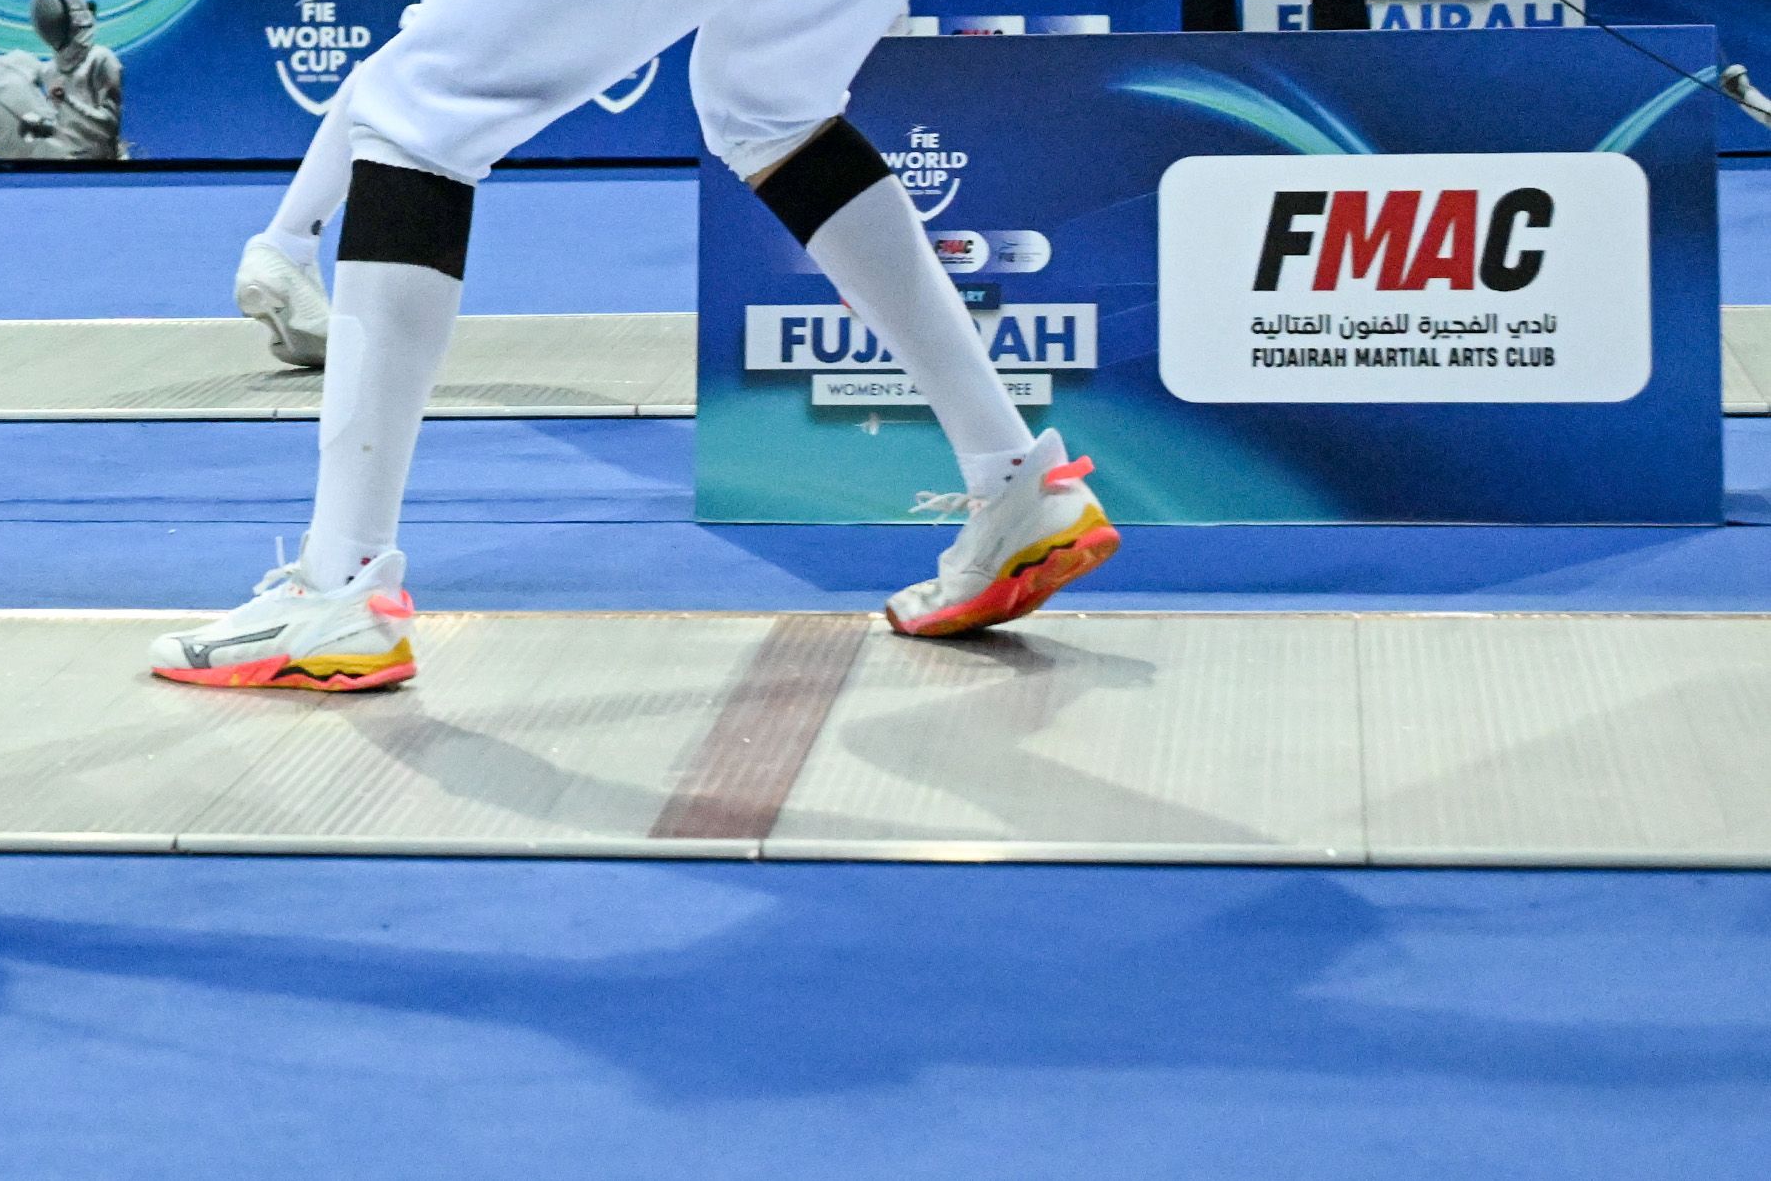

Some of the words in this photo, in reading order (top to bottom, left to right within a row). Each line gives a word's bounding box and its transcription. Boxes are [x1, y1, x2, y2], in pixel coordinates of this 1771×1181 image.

[301, 2, 336, 22] FIE
[265, 25, 371, 49] WORLD
[290, 49, 347, 72] CUP
[911, 133, 940, 149] FIE
[901, 170, 949, 189] CUP
[1251, 187, 1555, 292] FMAC
[1250, 313, 1331, 341] القتالية
[1338, 313, 1410, 341] للفنون
[1418, 313, 1498, 341] الفجيرة
[1507, 314, 1557, 340] نادي
[779, 315, 1076, 364] FUJAH
[1251, 346, 1347, 368] FUJAIRAH
[1354, 346, 1441, 368] MARTIAL
[1447, 346, 1498, 368] ARTS
[1505, 345, 1556, 368] CLUB
[827, 382, 905, 397] WOMEN'S
[1002, 382, 1033, 397] PEE
